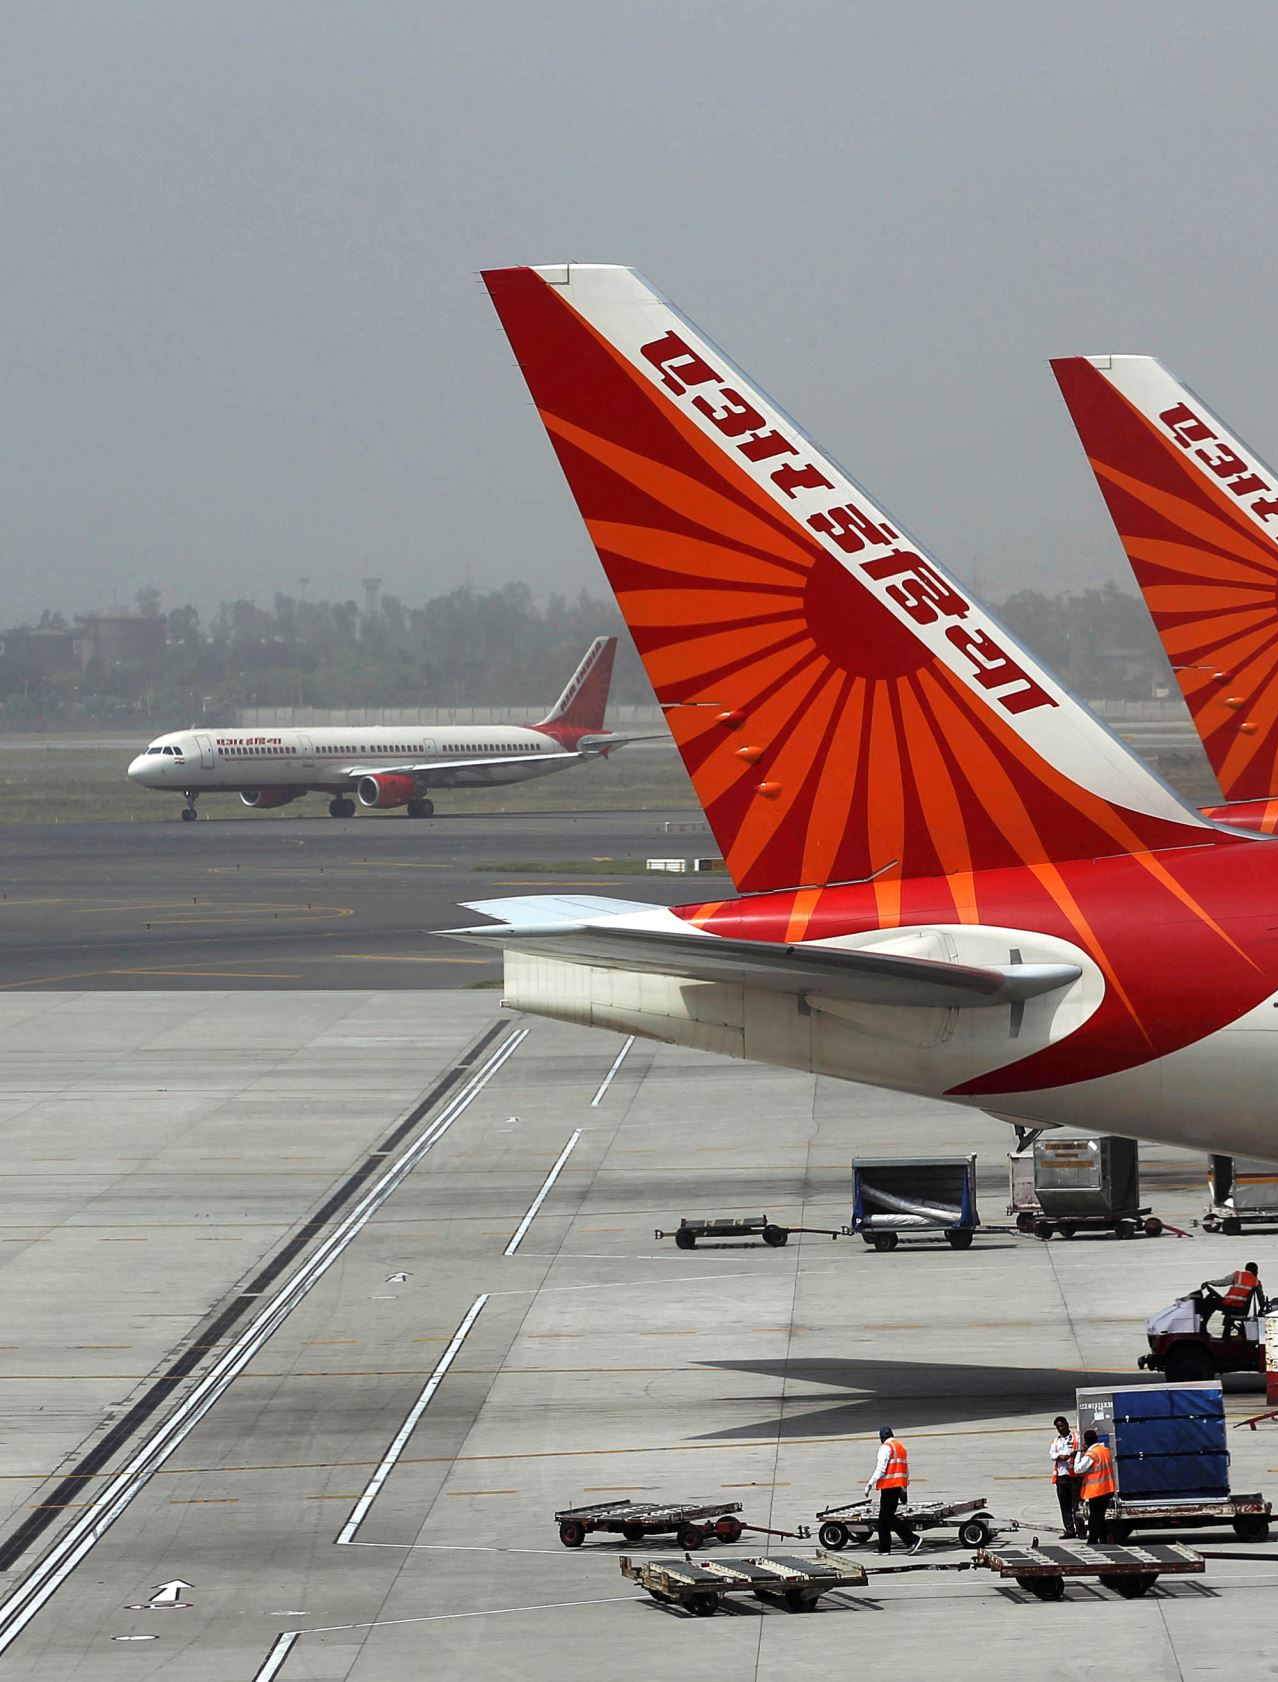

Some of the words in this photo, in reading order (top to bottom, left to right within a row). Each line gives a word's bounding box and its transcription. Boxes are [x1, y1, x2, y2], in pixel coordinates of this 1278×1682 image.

[560, 685, 577, 712] AIR
[575, 640, 602, 685] INDIA
[806, 503, 1060, 714] इंडिया
